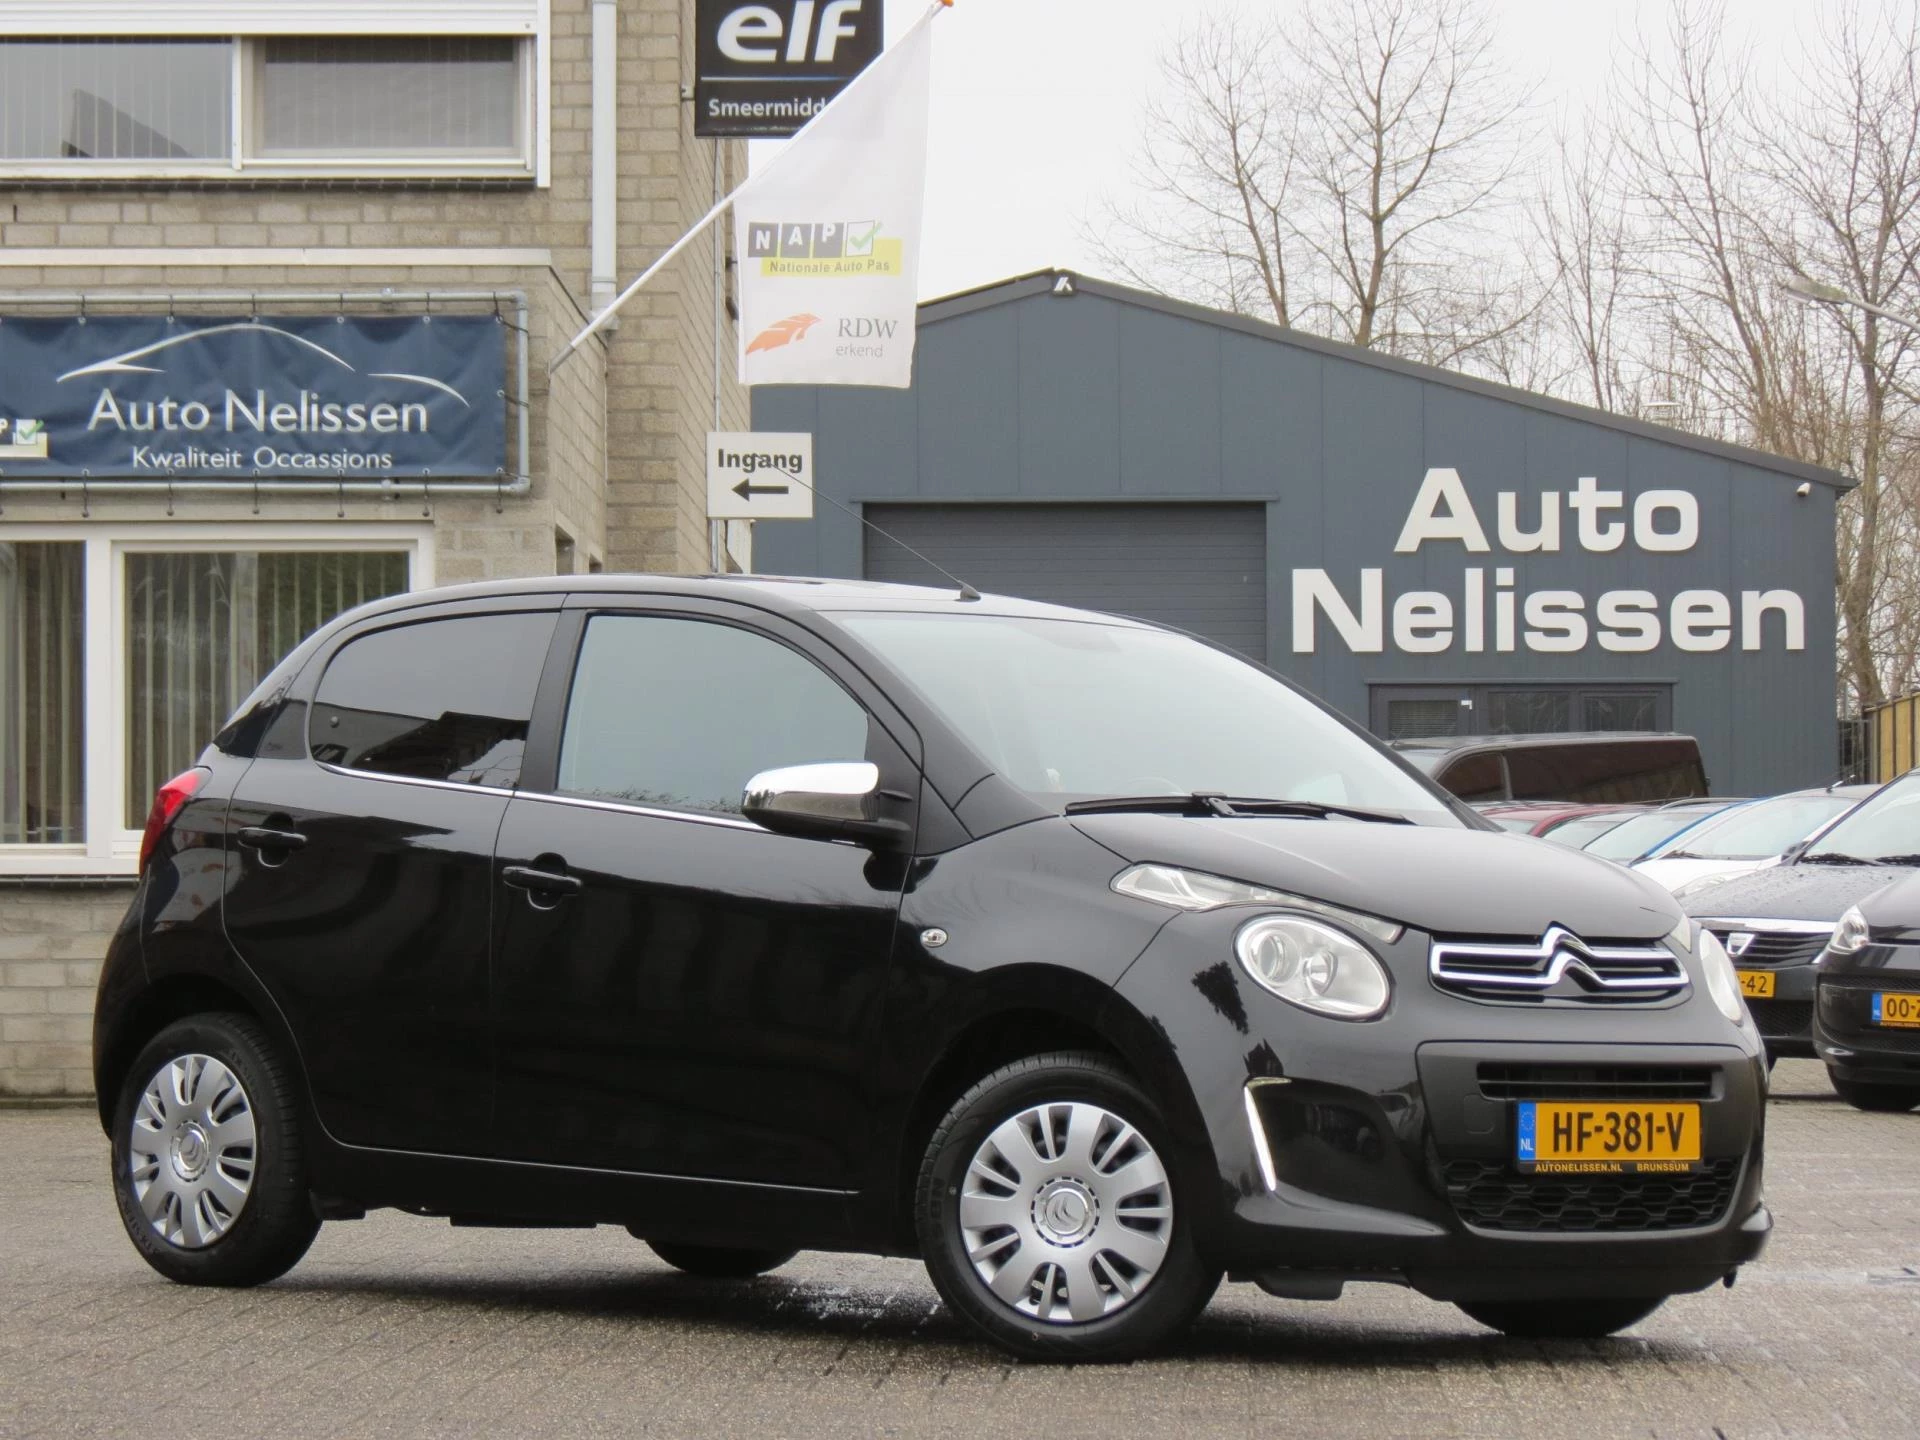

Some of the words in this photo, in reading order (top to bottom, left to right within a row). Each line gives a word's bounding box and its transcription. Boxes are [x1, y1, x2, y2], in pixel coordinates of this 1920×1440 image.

[716, 0, 862, 63] elf
[769, 260, 831, 273] Nationale
[834, 261, 863, 273] Auto
[867, 258, 890, 271] Pas
[838, 317, 899, 340] RDW
[836, 343, 884, 358] erkend
[87, 387, 211, 432] Auto
[225, 388, 428, 433] Nelissen
[132, 445, 242, 469] Kwaliteit
[253, 446, 393, 470] Occassions
[717, 448, 803, 474] Ingang
[1393, 467, 1700, 553] Auto
[1291, 566, 1806, 653] Nelissen
[1520, 1137, 1533, 1151] NL
[1552, 1111, 1685, 1153] HF-381-V
[1535, 1161, 1623, 1173] AUTONELISSEN.NL
[1636, 1161, 1689, 1172] BRUNSSUM
